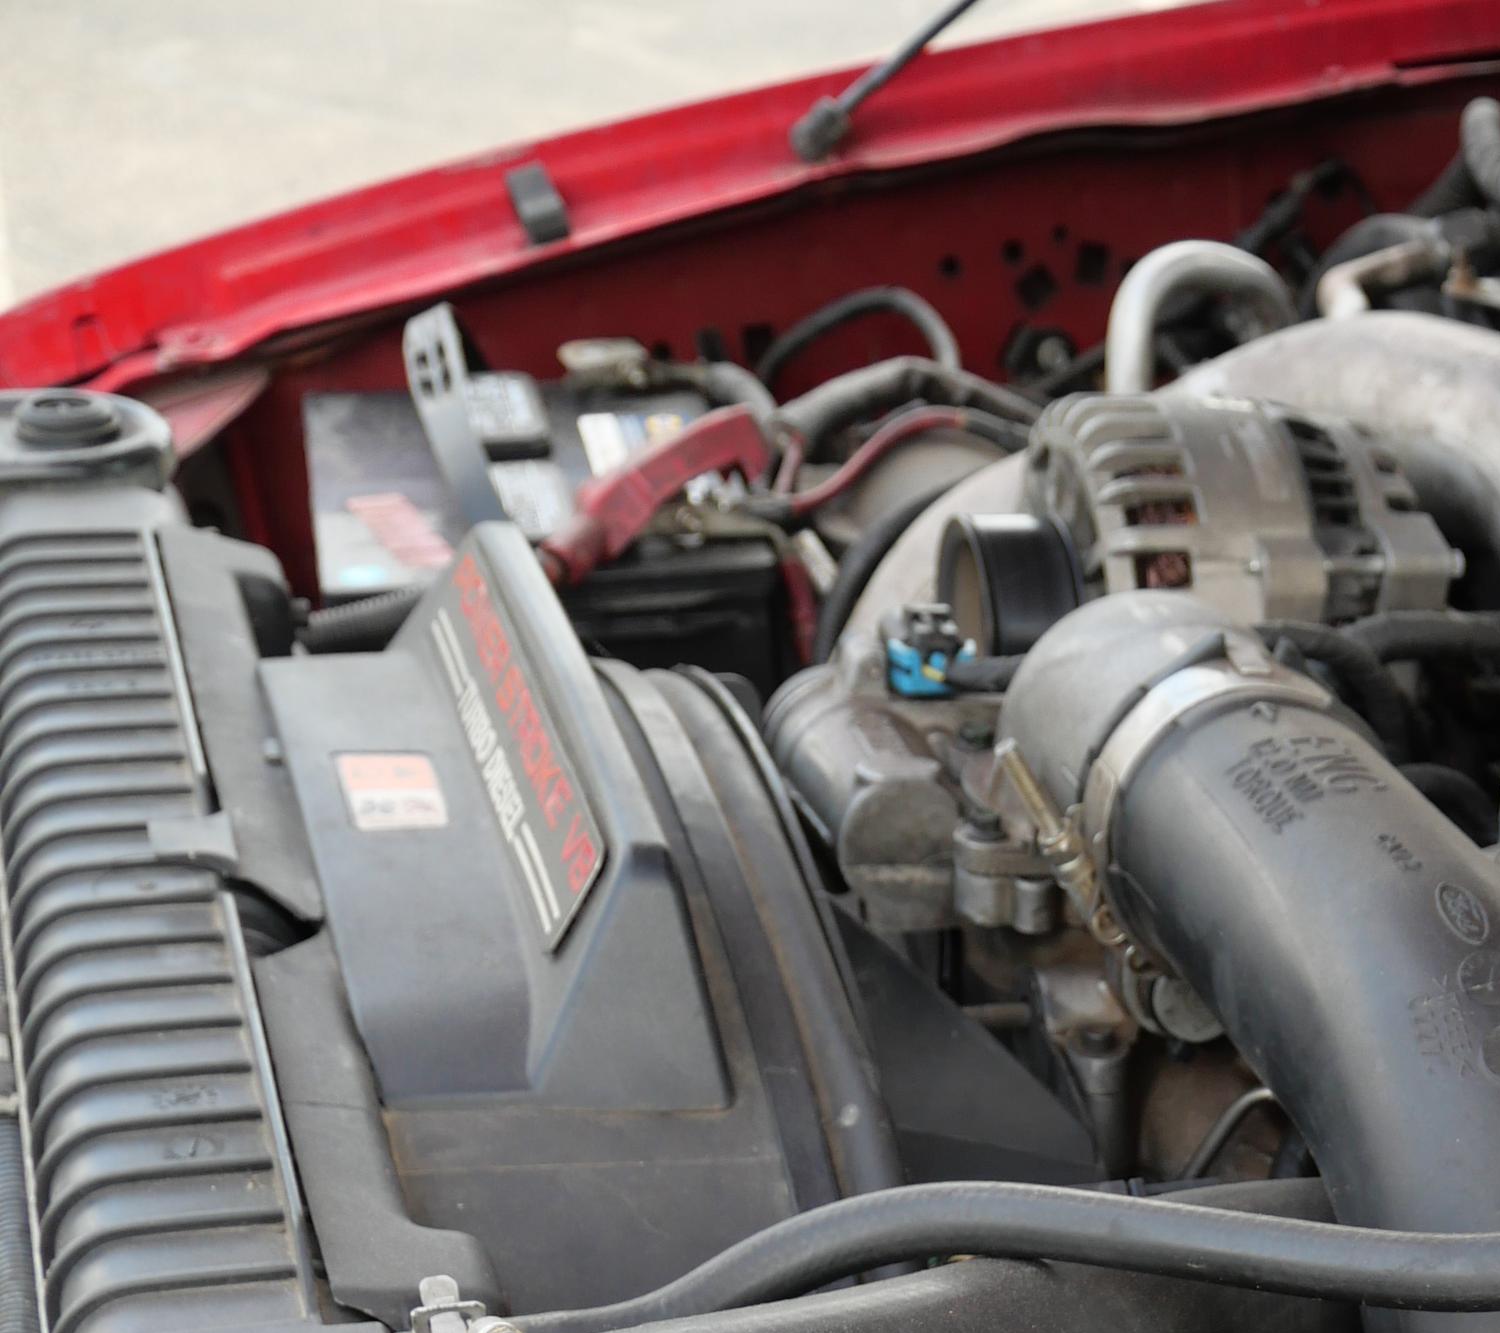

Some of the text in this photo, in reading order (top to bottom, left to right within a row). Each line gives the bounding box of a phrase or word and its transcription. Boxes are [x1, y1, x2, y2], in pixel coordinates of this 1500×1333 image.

[457, 679, 524, 842] TURBO DIESEL
[496, 665, 573, 831] STROKE
[562, 813, 596, 894] V8
